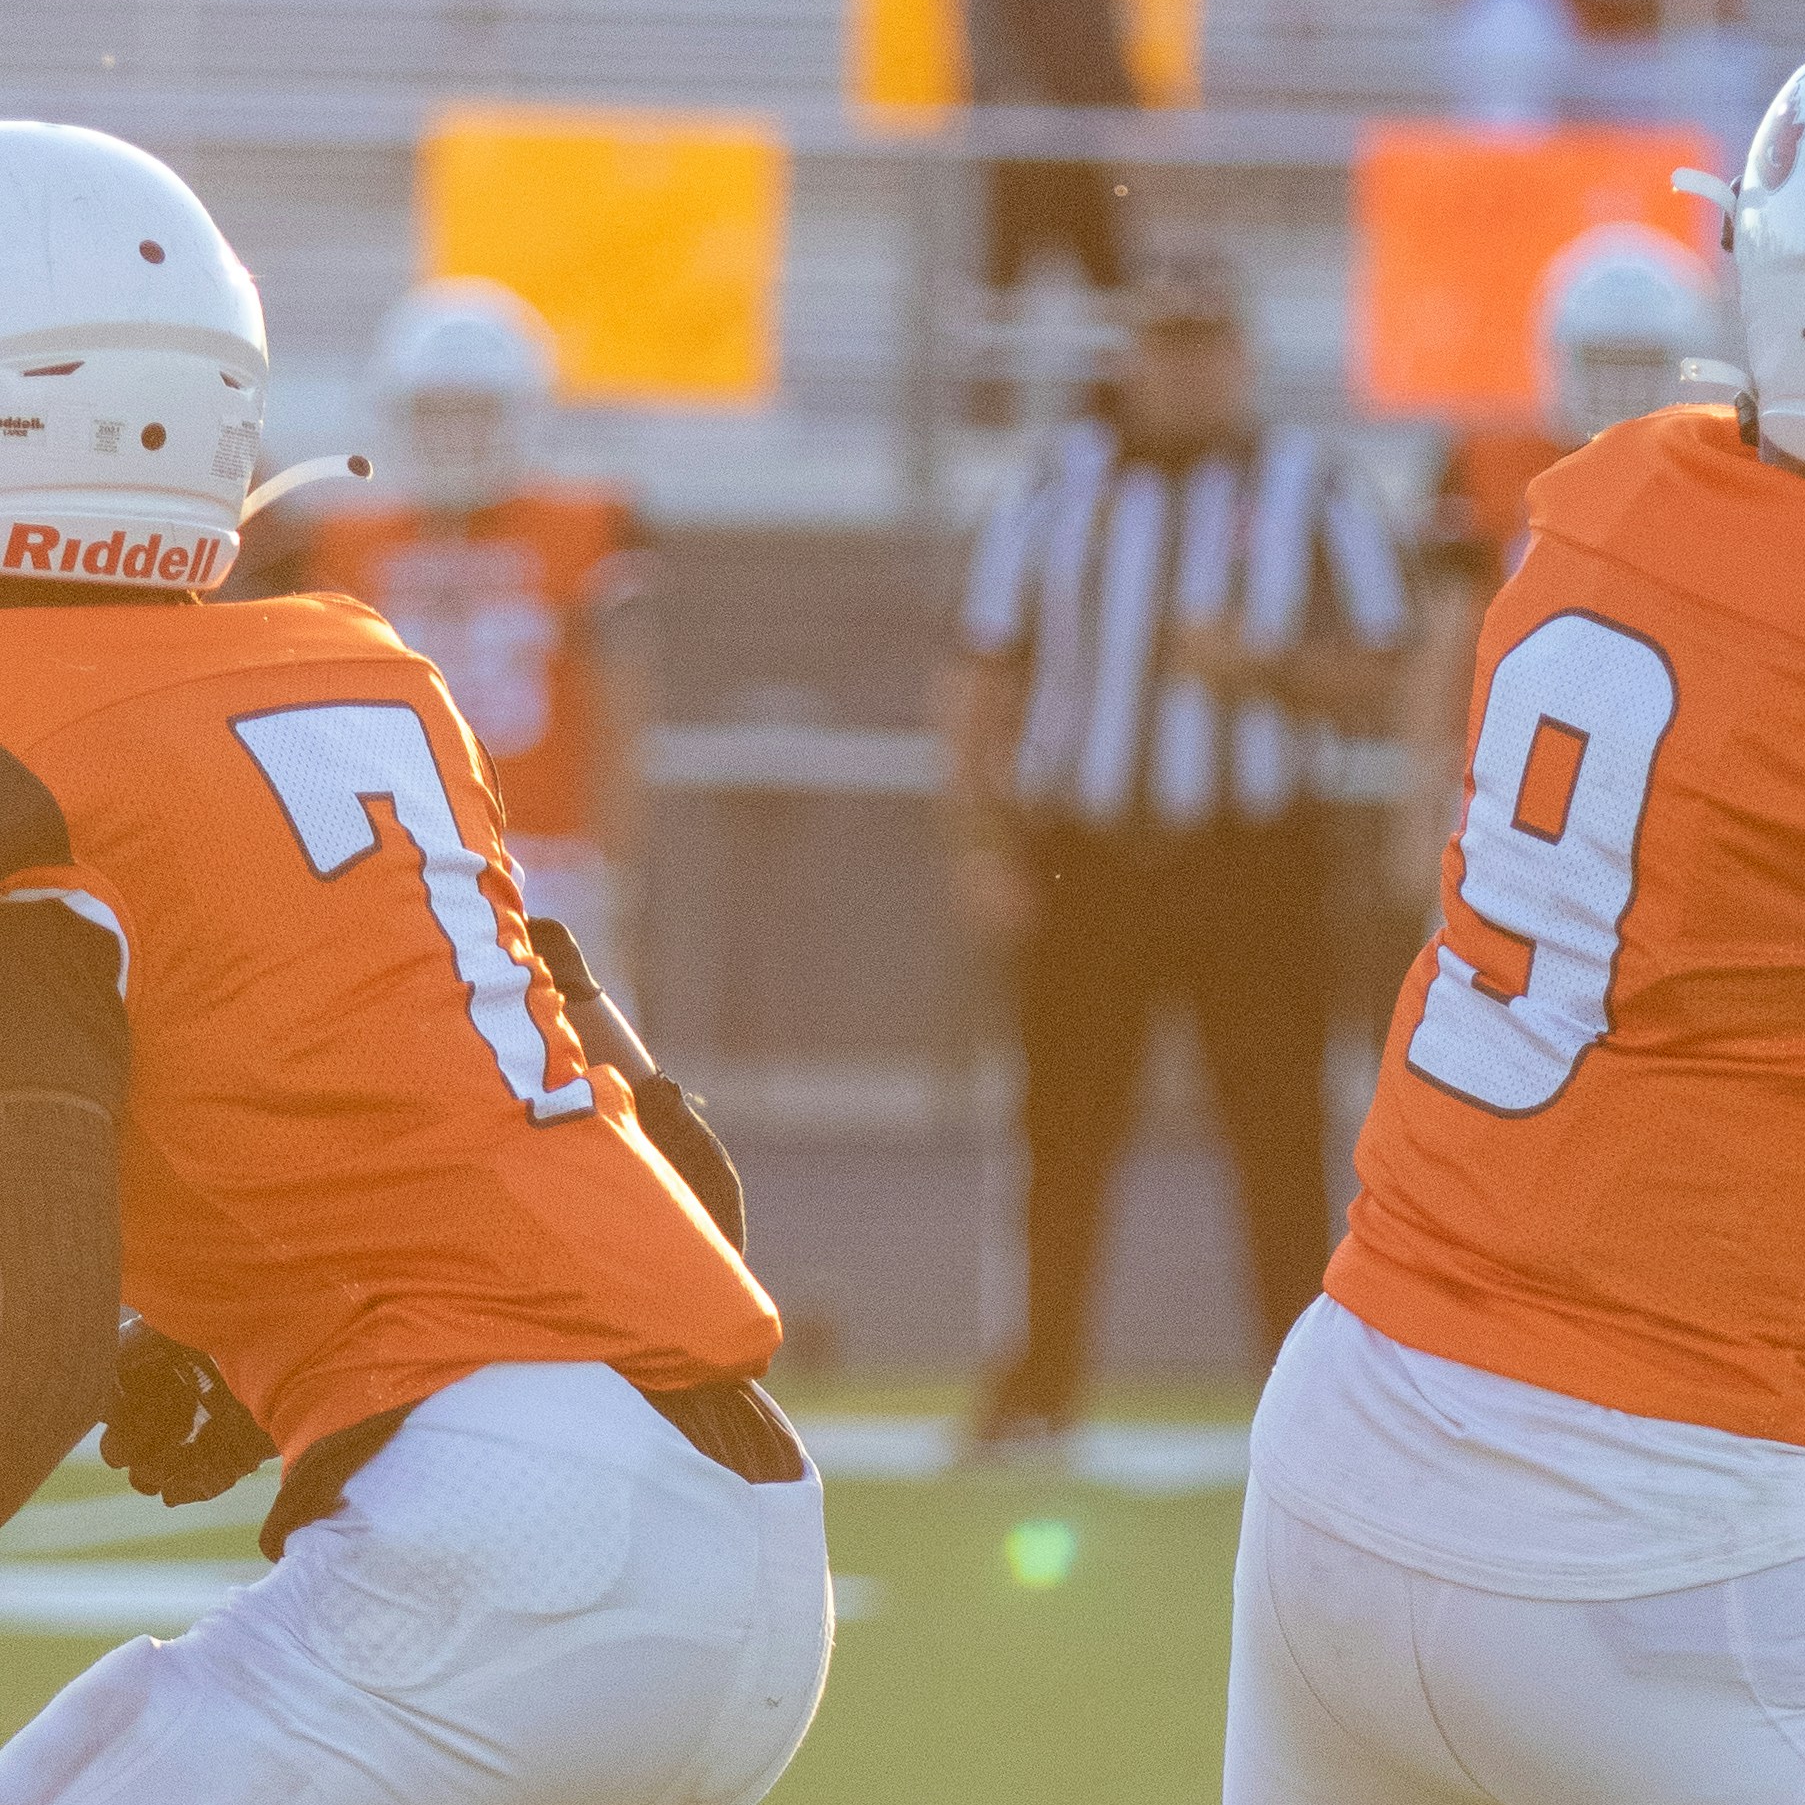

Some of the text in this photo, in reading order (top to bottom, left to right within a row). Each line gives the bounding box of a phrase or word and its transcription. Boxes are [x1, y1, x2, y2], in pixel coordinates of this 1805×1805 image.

[2, 522, 221, 584] Riddell
[227, 698, 597, 1129] 7
[1405, 606, 1679, 1119] 9
